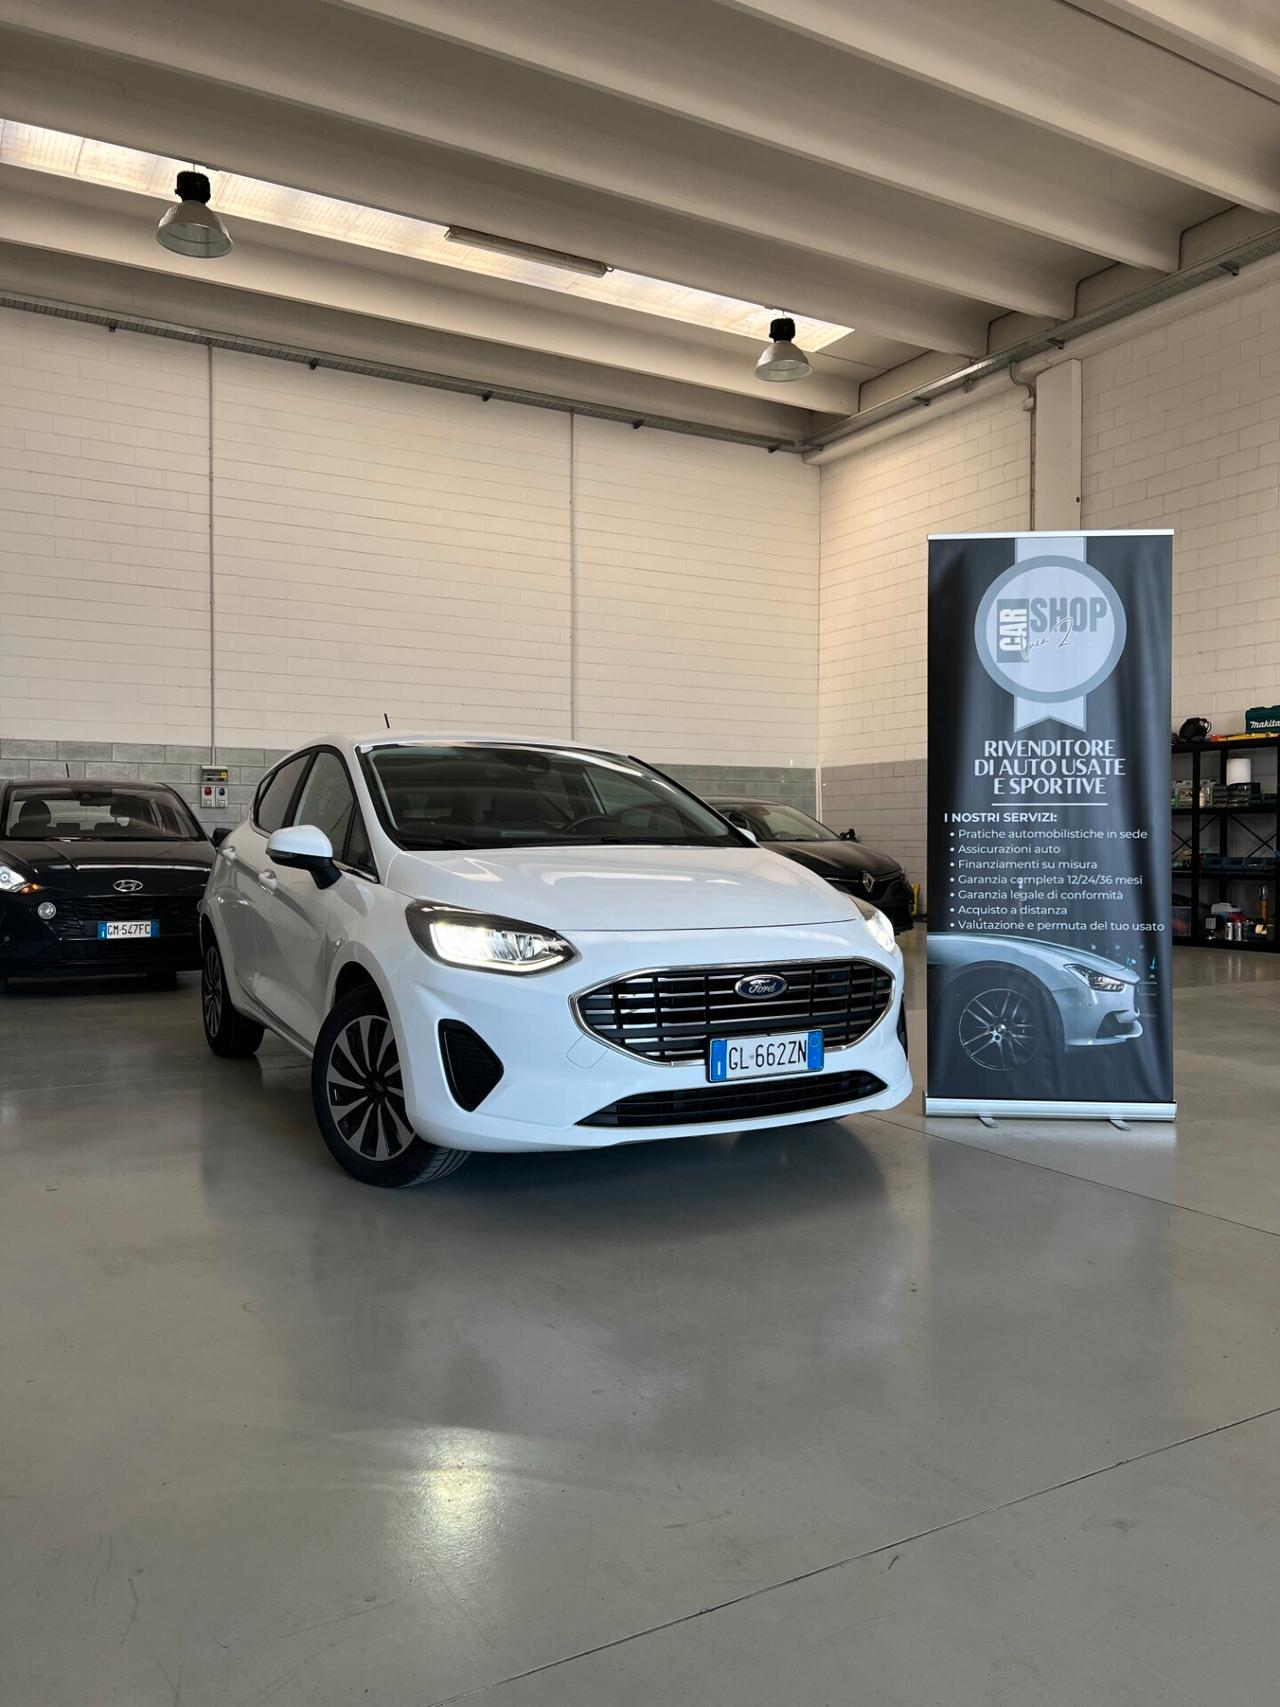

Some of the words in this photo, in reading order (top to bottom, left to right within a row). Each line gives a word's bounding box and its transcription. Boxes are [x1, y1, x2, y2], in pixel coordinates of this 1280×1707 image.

[1030, 597, 1107, 633] SHOP
[999, 608, 1028, 652] CAR
[984, 740, 1116, 757] RIVENDITORE
[975, 759, 994, 776] DI
[999, 759, 1057, 775] AUTO
[1062, 759, 1126, 775] USATE
[994, 778, 1006, 794] E
[1010, 778, 1106, 794] SPORTIVE
[944, 813, 948, 822] I
[952, 813, 1000, 822] NOSTRI
[1003, 813, 1057, 822] SERVIZI:
[959, 830, 1005, 839] Pratiche
[1009, 830, 1104, 839] automobilistiche
[1107, 830, 1117, 838] in
[1120, 830, 1147, 839] sede
[958, 845, 1031, 854] Assicurazioni
[1034, 846, 1060, 854] auto
[959, 860, 1039, 869] Finanziamenti
[1058, 861, 1097, 869] misura
[958, 875, 1007, 884] Garanzia
[1010, 875, 1064, 886] completa
[1067, 875, 1112, 885] 12/24/36
[1116, 876, 1142, 885] mesi
[958, 891, 1007, 899] Garanzia
[1010, 891, 1044, 901] legale
[1047, 891, 1058, 900] di
[1061, 891, 1123, 900] conformità
[958, 906, 1007, 916] Acquisto
[1020, 906, 1067, 915] distanza
[958, 920, 1024, 929] Valutazione
[1037, 922, 1086, 932] permuta
[1090, 921, 1107, 930] del
[1110, 922, 1129, 931] tuo
[1132, 923, 1164, 931] usato
[748, 980, 776, 994] Ford
